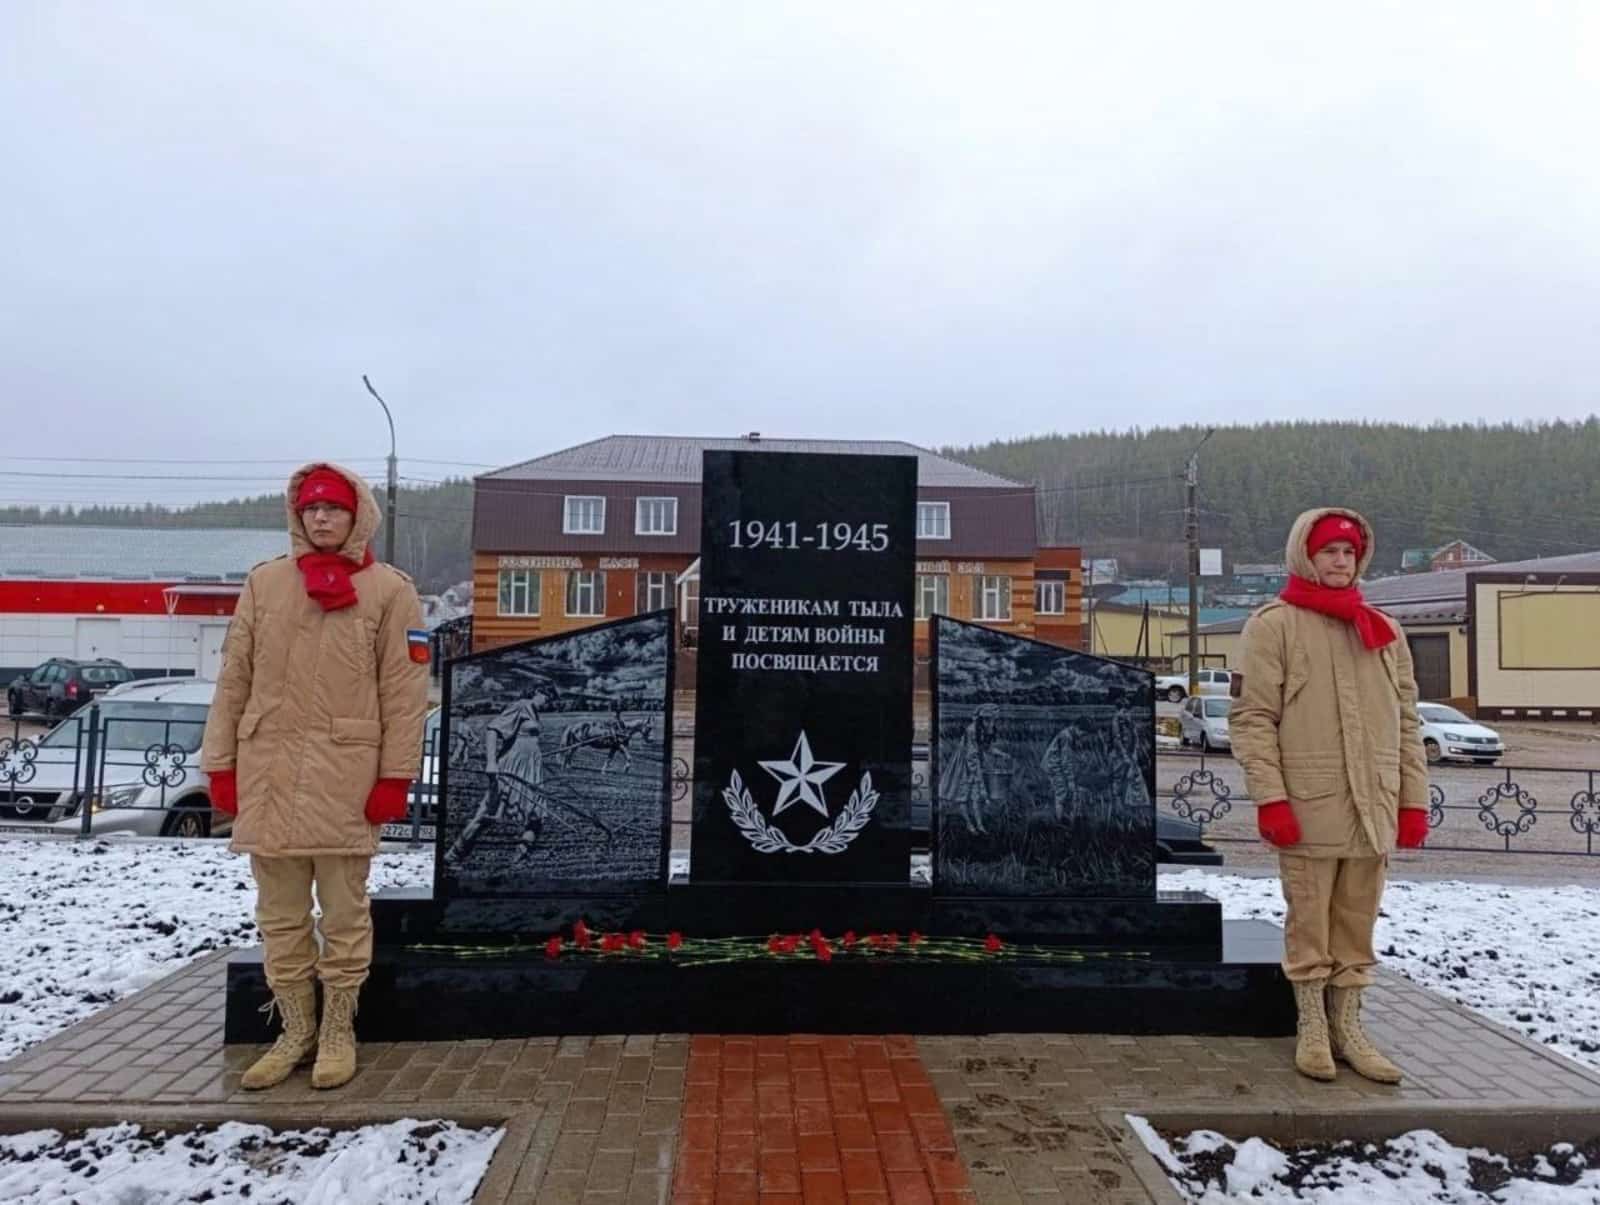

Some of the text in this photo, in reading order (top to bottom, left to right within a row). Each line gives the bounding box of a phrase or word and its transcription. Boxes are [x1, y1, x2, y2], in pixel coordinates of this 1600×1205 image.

[729, 519, 889, 552] 1941-1945
[704, 597, 904, 618] ТРУЖЕНИКАМ ТЫЛА
[722, 624, 885, 645] И ДЕТЯМ ВОЙНЫ
[731, 653, 879, 673] ПОСВЯЩАЕТСЯ
